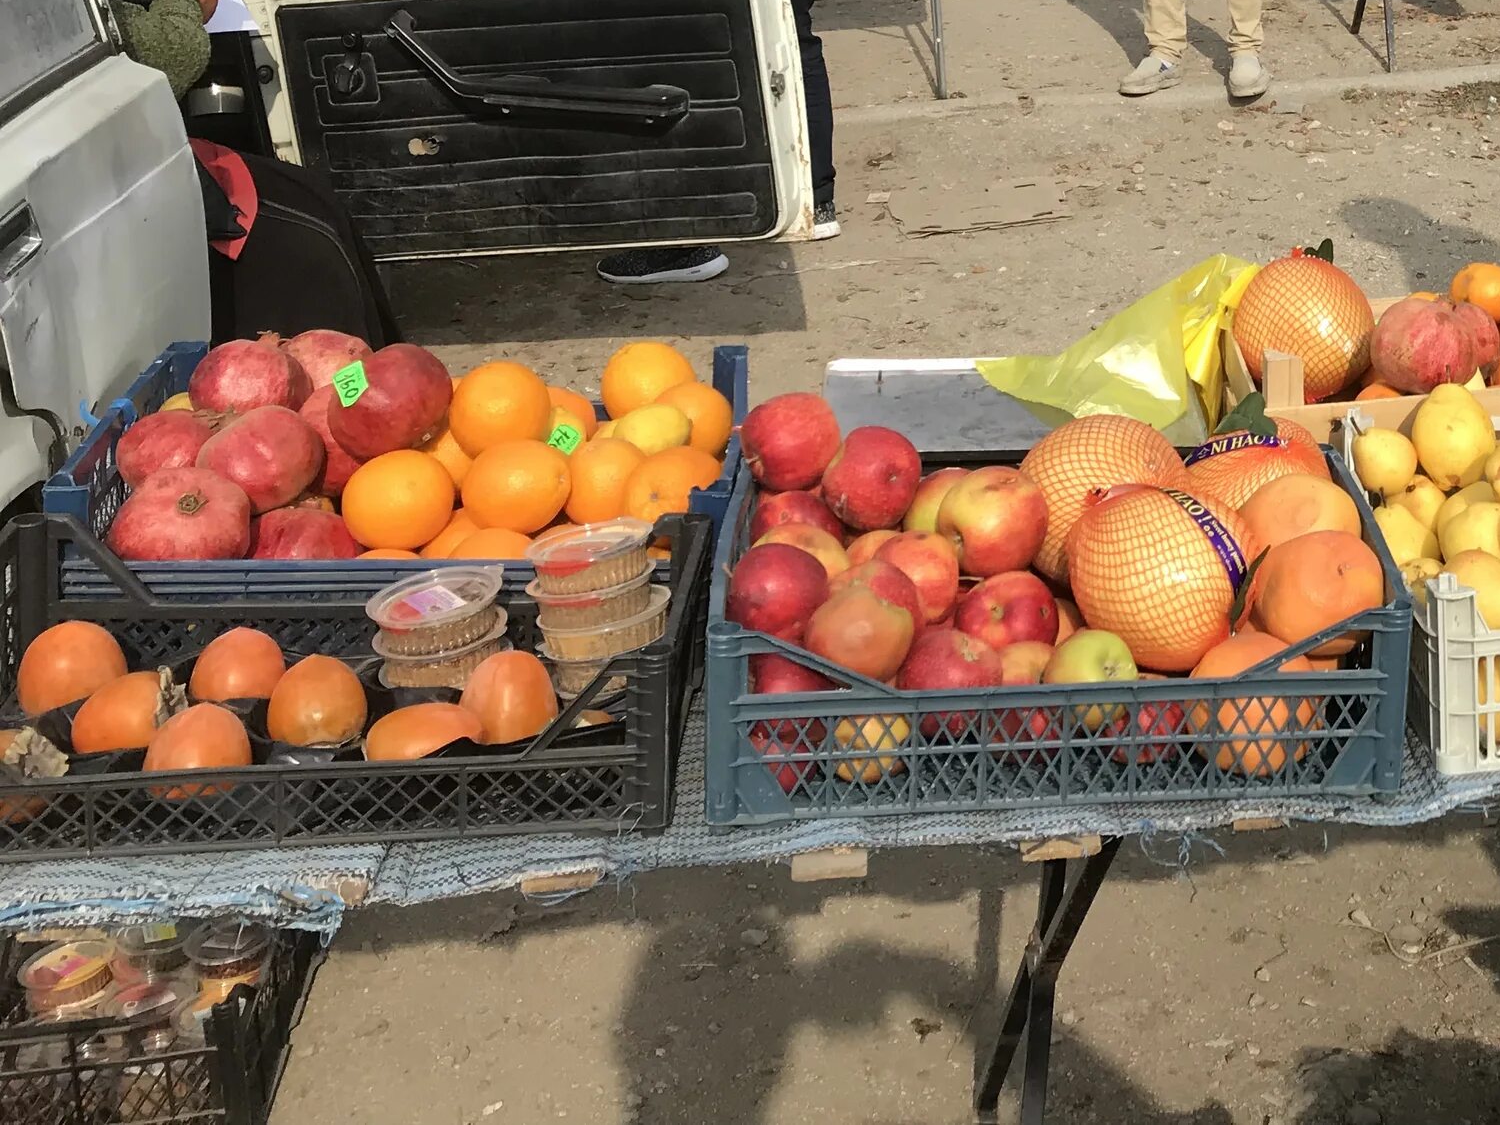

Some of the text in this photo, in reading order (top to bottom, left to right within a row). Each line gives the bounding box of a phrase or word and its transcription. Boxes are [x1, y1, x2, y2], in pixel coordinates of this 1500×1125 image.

[1210, 439, 1228, 456] NI
[1230, 435, 1266, 449] HAO
[1168, 490, 1205, 516] HAO
